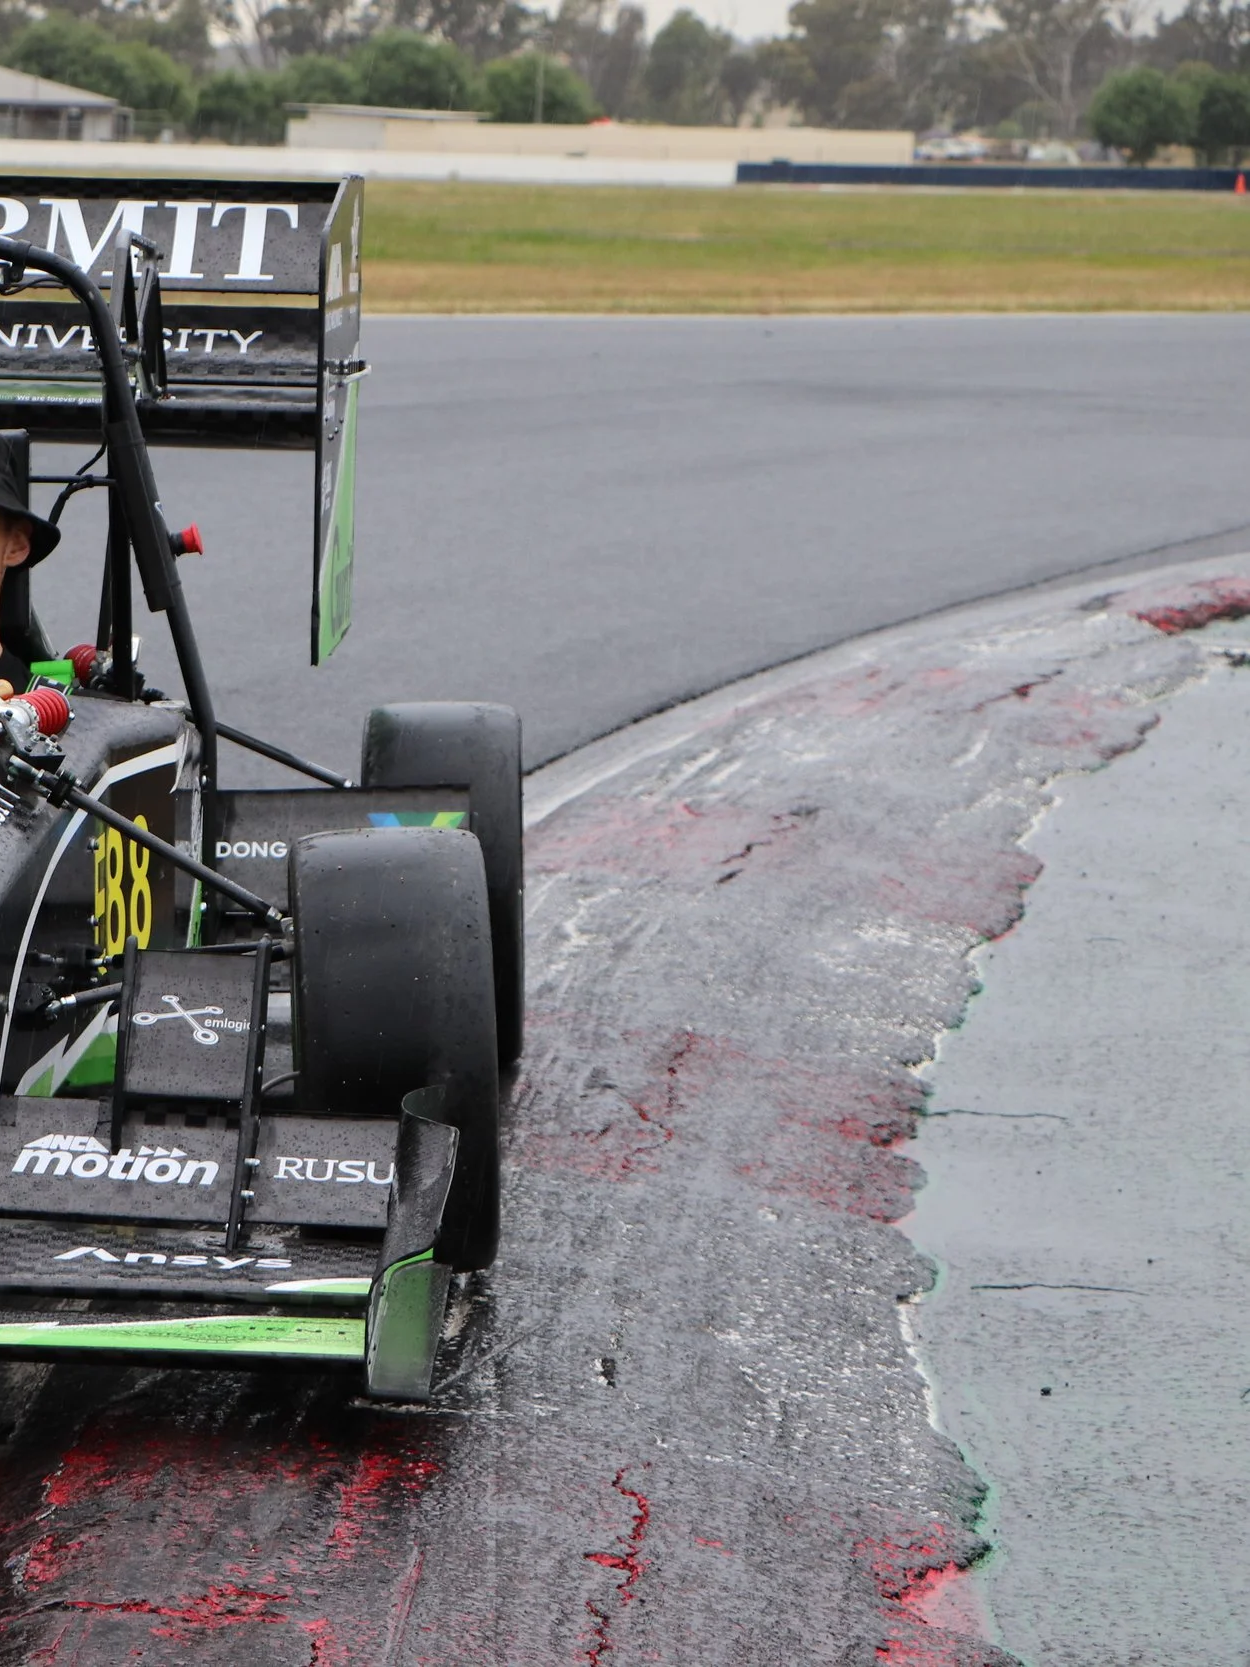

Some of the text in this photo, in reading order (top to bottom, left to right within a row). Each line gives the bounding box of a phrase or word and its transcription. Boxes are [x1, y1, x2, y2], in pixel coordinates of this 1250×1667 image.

[46, 395, 77, 403] forever
[24, 1133, 110, 1153] ANCA
[11, 1147, 220, 1185] motion
[273, 1156, 395, 1184] RUSU
[52, 1246, 293, 1269] Ansys
